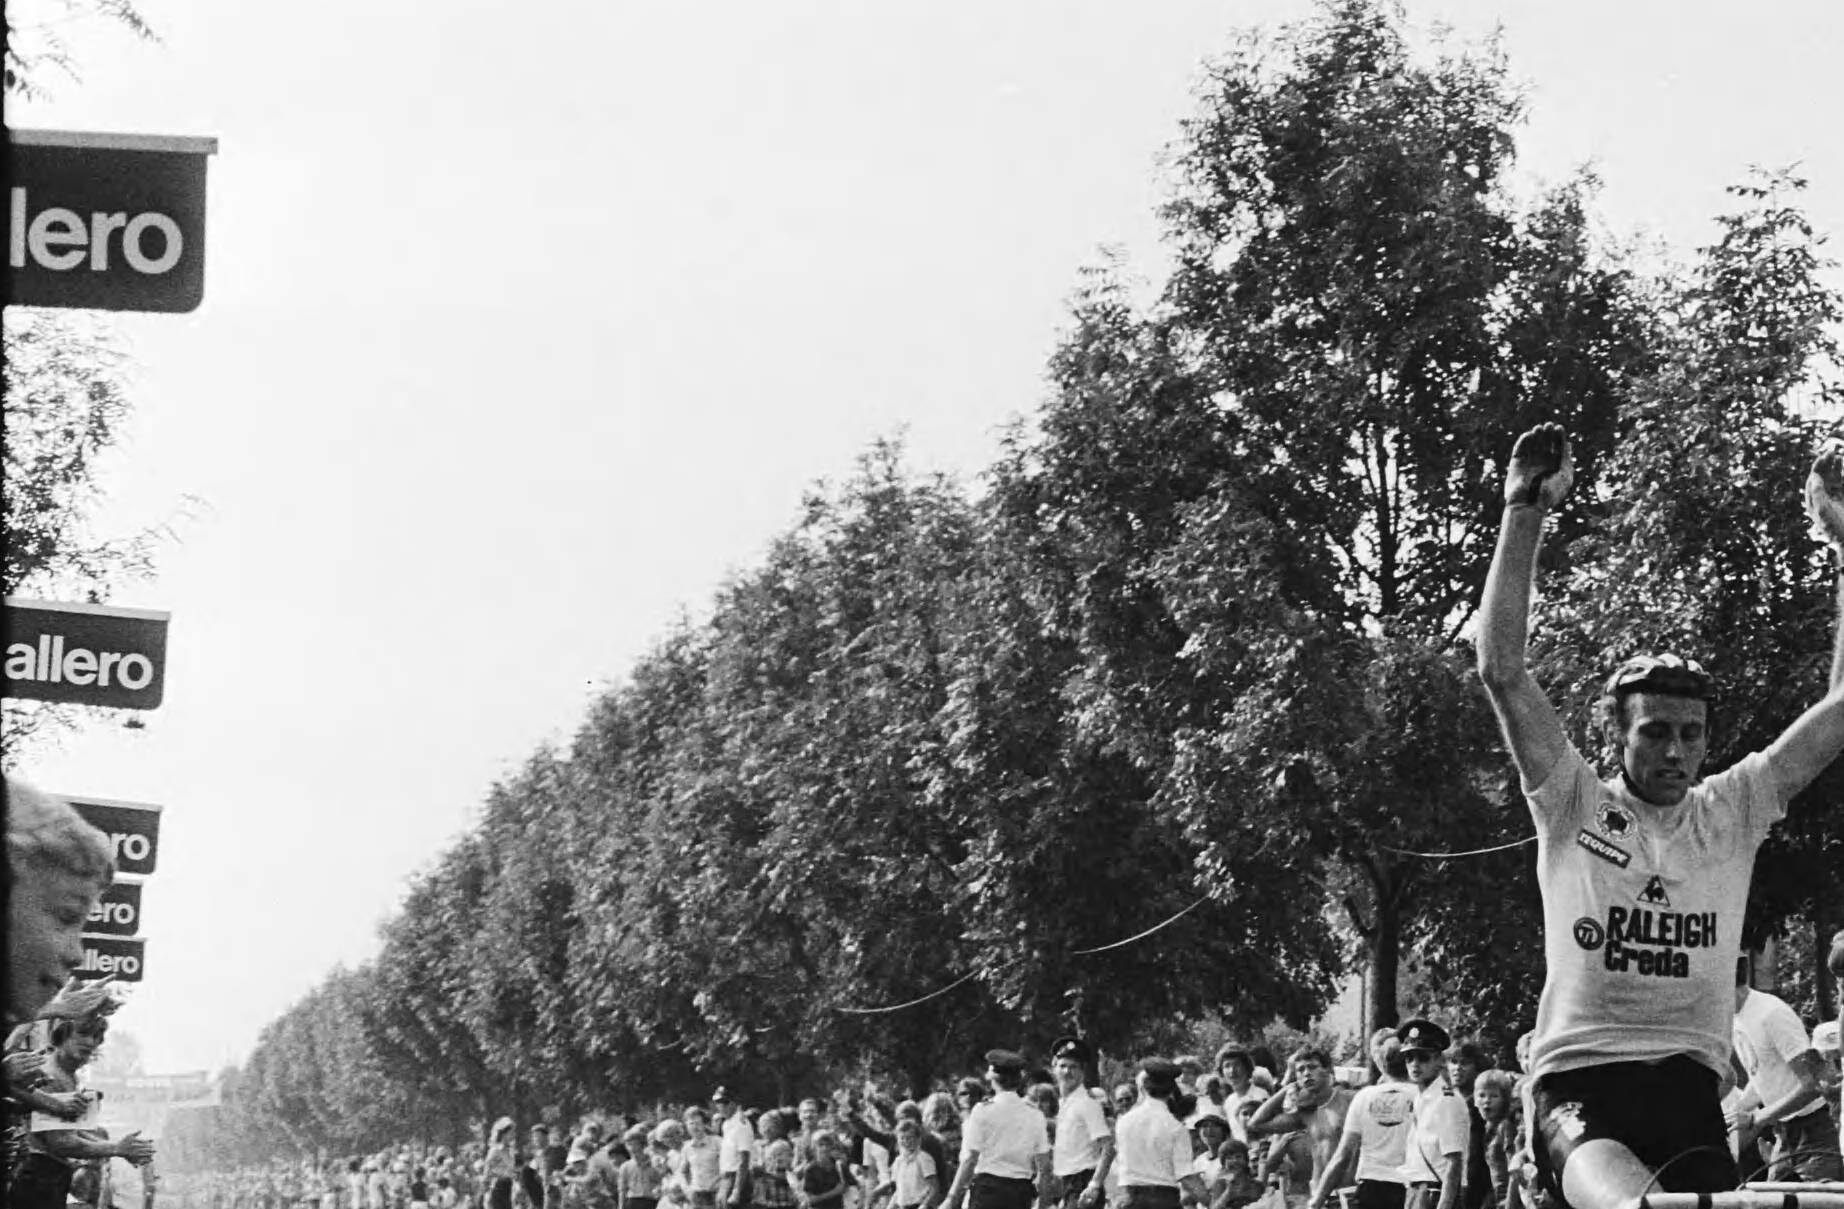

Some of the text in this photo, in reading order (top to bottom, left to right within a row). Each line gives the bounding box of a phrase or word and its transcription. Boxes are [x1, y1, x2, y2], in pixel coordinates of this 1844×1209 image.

[4, 634, 153, 690] allero
[1606, 906, 1717, 948] RALEIGH
[1605, 940, 1689, 978] Creda
